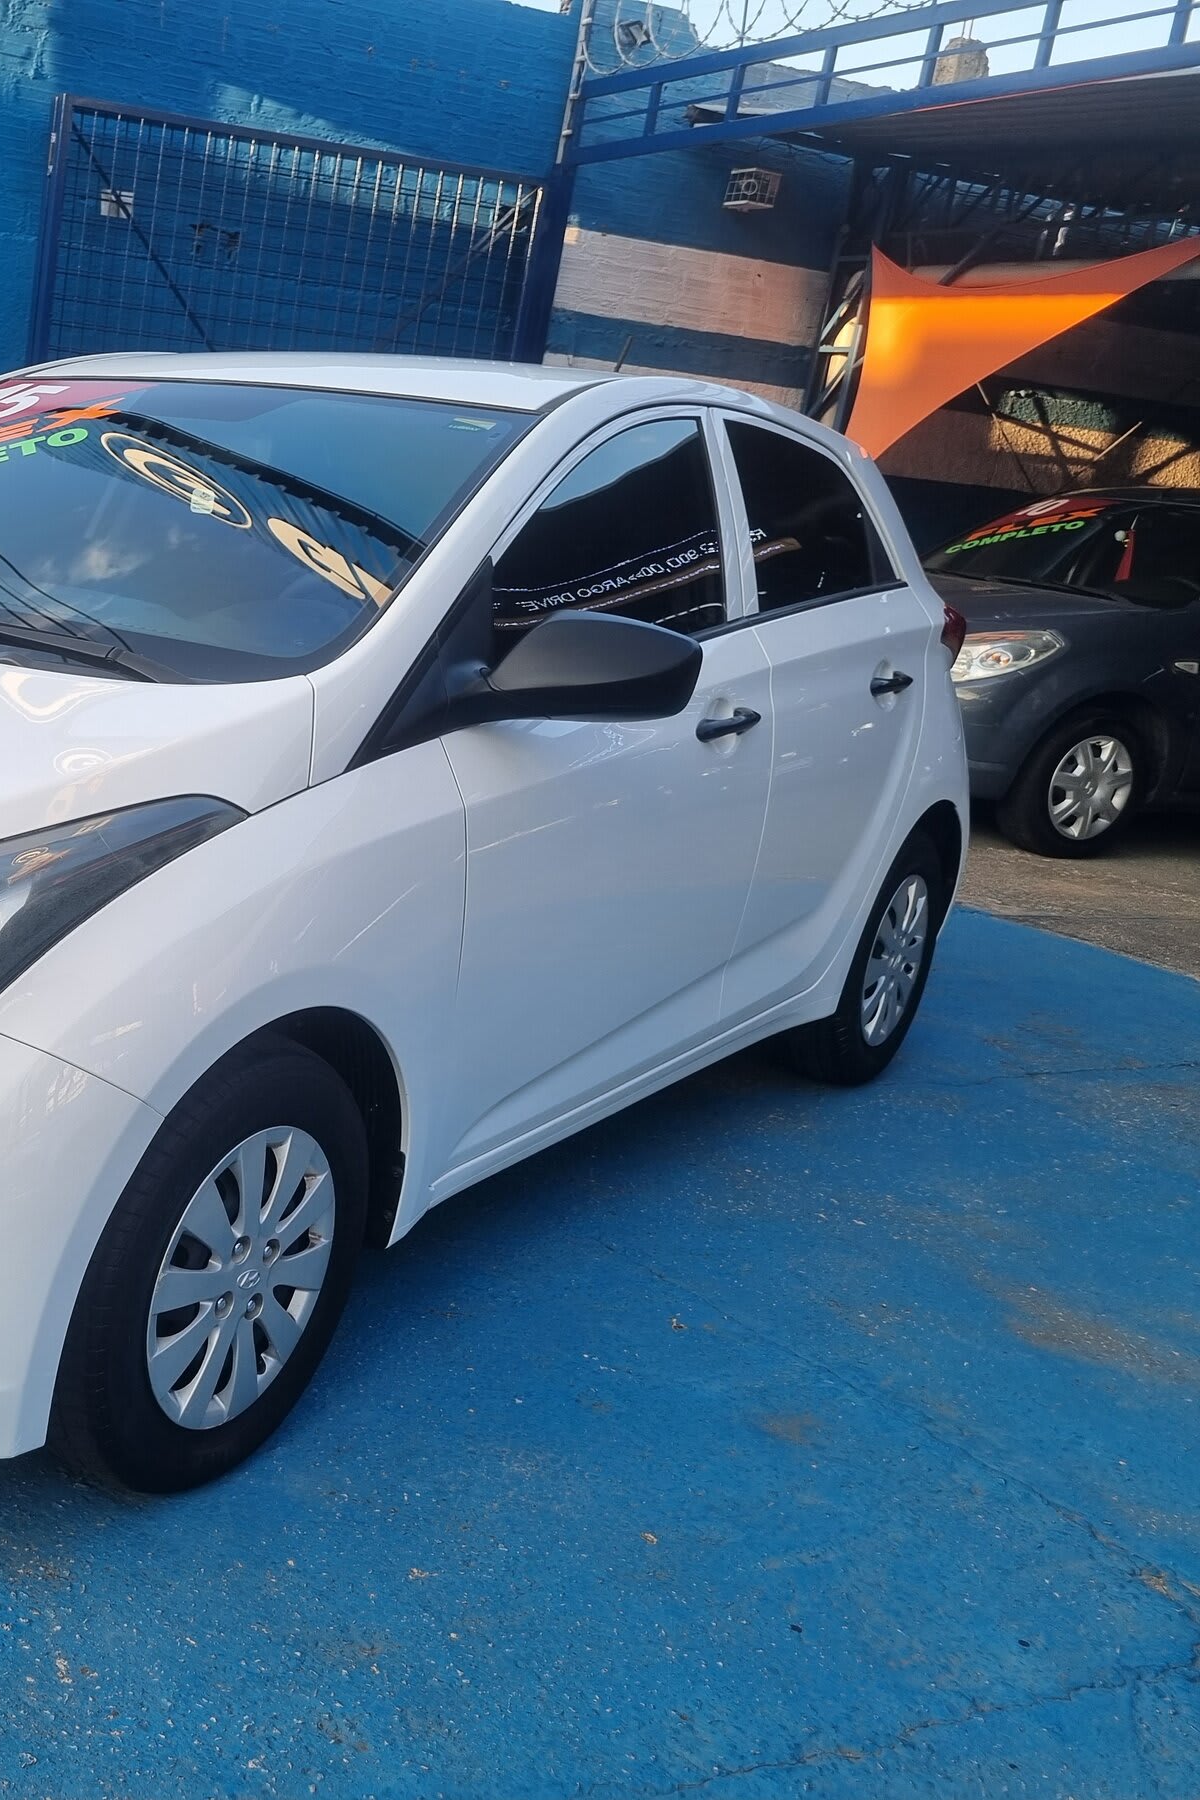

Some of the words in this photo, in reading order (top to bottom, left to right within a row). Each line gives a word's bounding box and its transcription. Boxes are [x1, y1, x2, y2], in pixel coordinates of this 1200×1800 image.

[964, 507, 1106, 543] FLEX
[1015, 498, 1071, 517] 10
[944, 519, 1086, 555] COMPLETO
